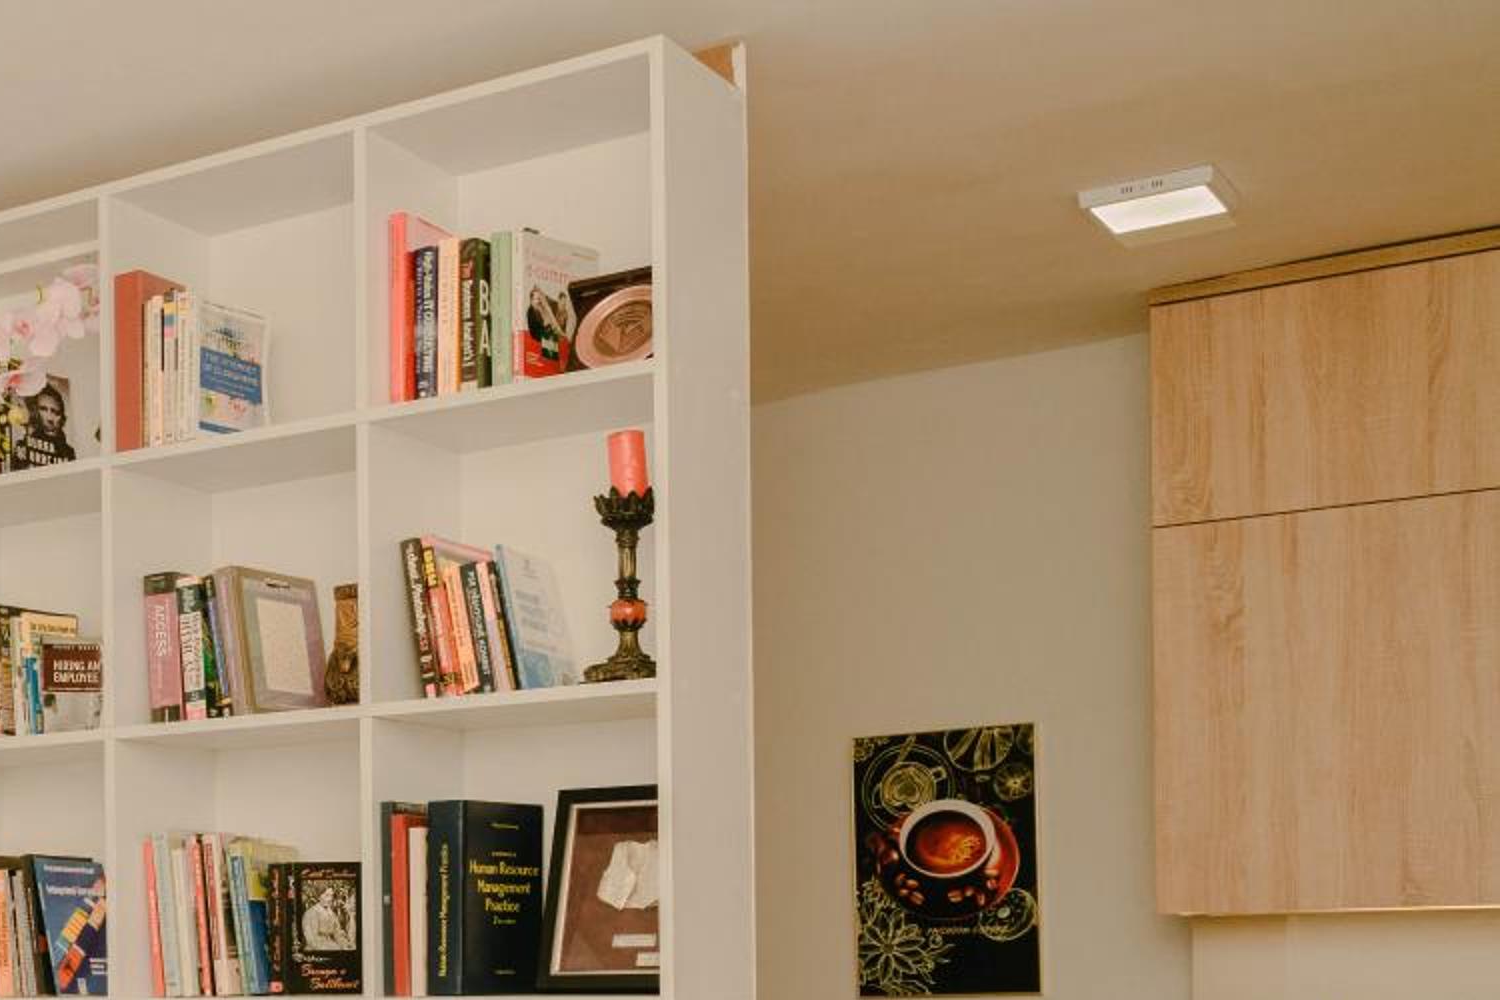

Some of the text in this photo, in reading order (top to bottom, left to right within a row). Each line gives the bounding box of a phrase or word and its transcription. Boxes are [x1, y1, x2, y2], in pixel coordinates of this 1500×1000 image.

[469, 859, 540, 877] Human Resource
[477, 878, 531, 897] Management
[485, 899, 521, 913] Practice
